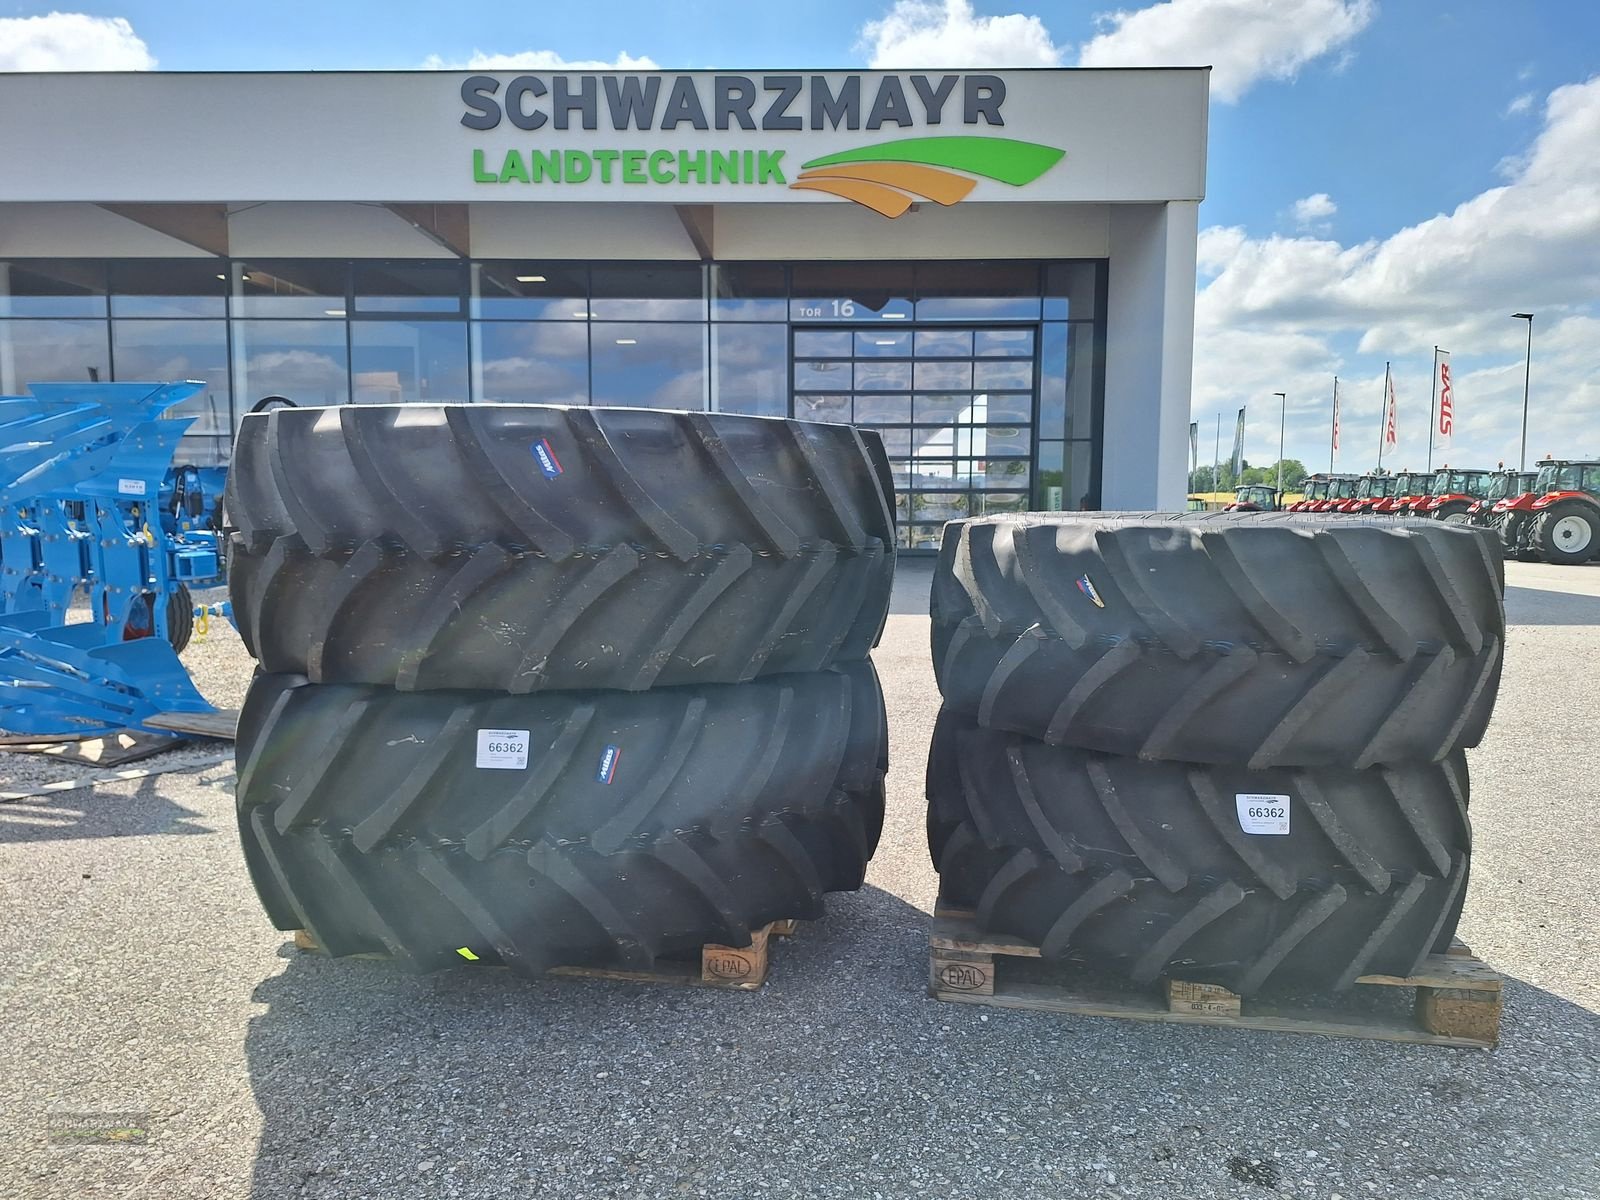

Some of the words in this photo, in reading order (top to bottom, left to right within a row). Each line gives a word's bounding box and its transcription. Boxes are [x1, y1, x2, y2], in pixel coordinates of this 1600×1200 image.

[460, 75, 1006, 131] SCHWARZMAYR
[473, 149, 788, 184] LANDTECHNIK
[799, 307, 822, 317] TOR
[831, 299, 856, 317] 16
[1439, 363, 1452, 437] STEYR
[488, 742, 524, 753] 66362
[1248, 807, 1285, 818] 66362
[948, 967, 979, 986] EPAL
